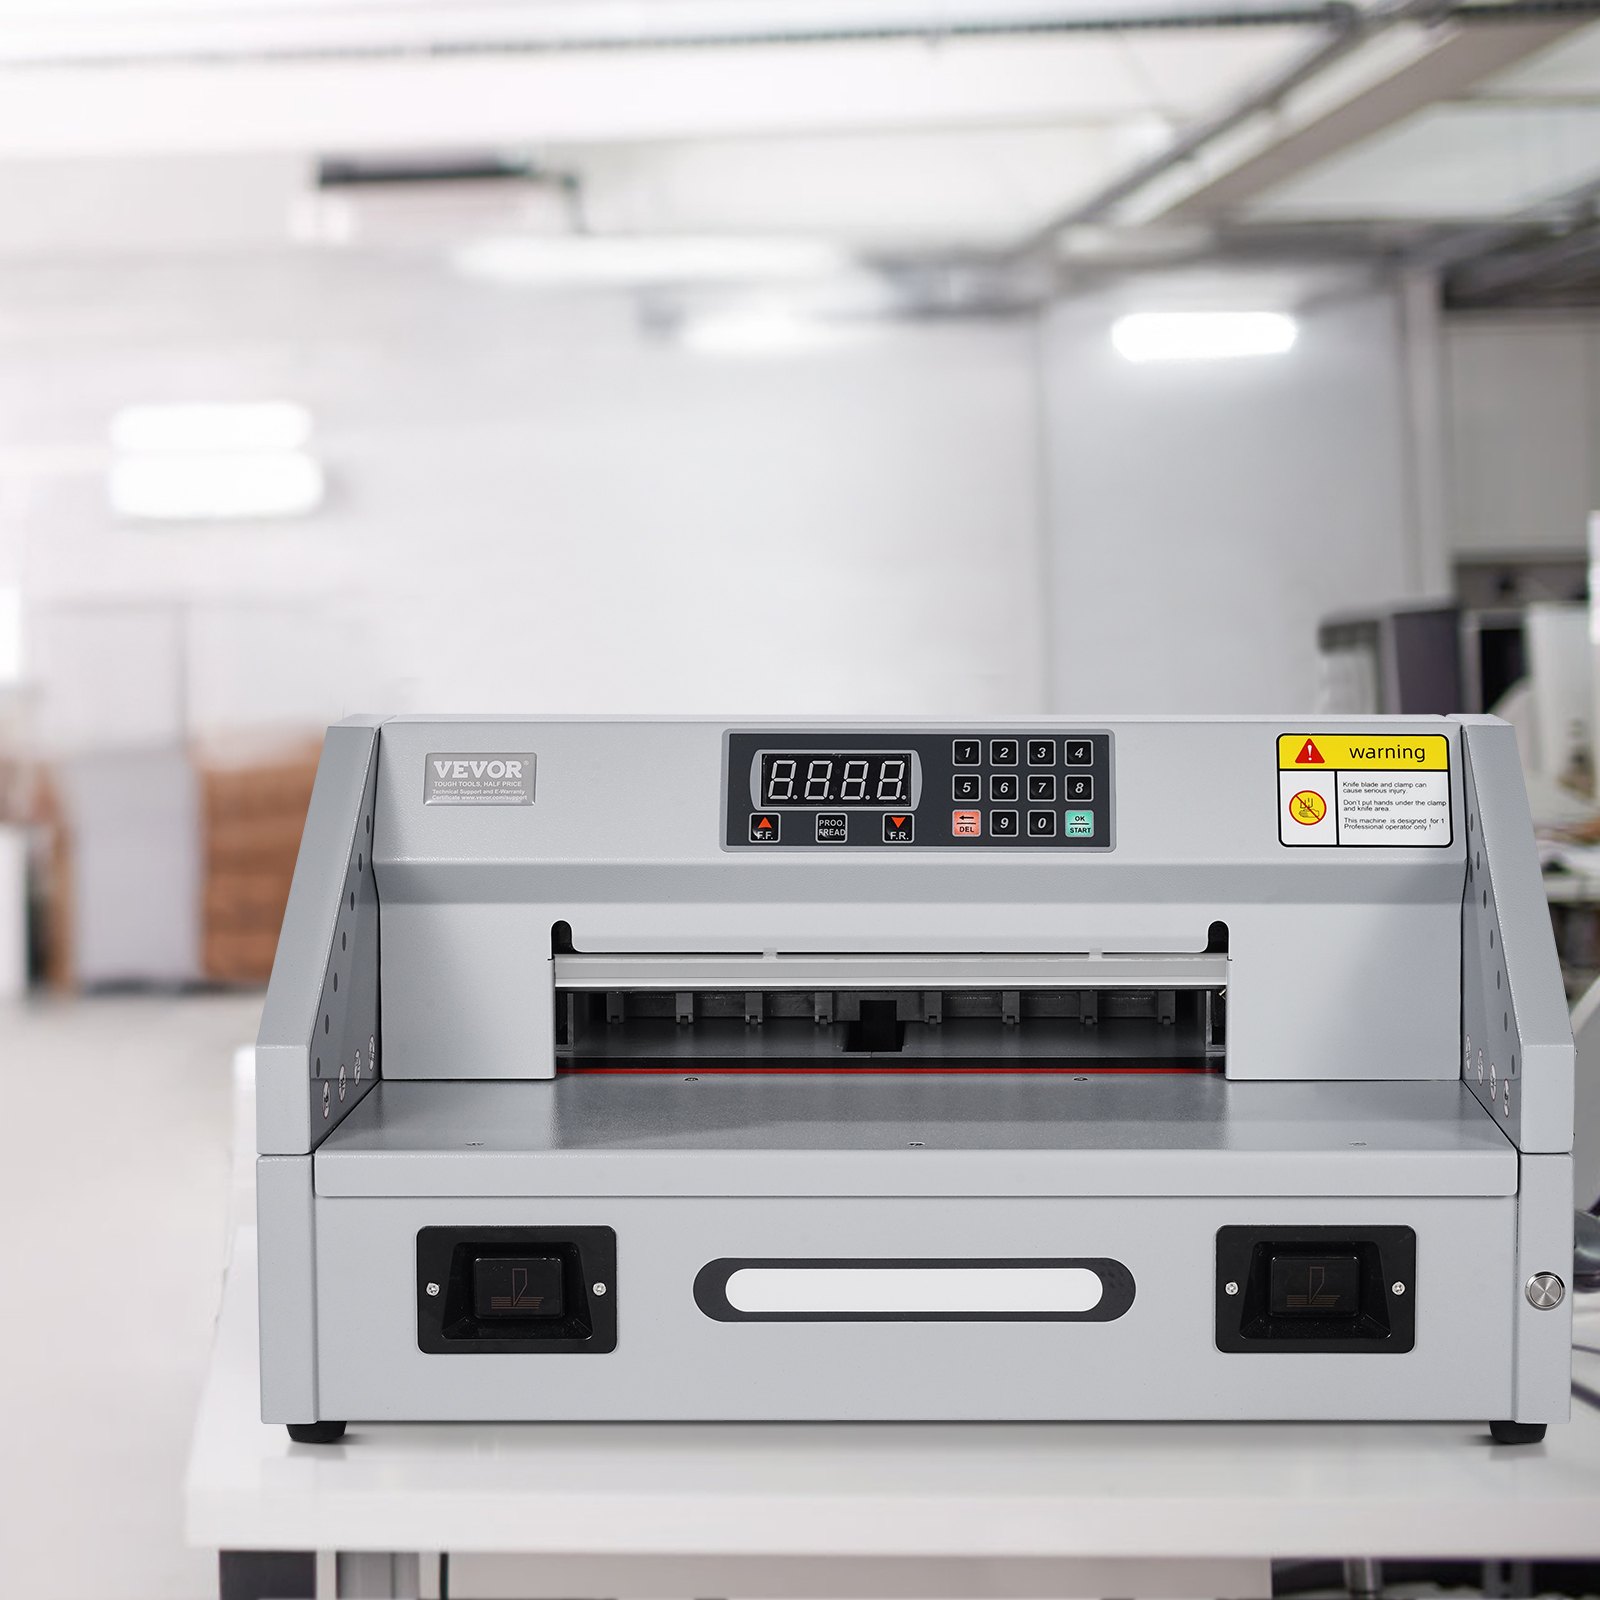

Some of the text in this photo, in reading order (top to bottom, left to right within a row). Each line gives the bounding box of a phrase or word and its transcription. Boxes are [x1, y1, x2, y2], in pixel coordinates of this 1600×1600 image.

[964, 747, 971, 758] 1
[999, 747, 1009, 758] 2
[1037, 747, 1046, 758] 3
[1074, 747, 1084, 758] 4
[1349, 744, 1426, 763] warning
[962, 782, 972, 793] 5
[1000, 782, 1009, 793] 6
[1038, 782, 1046, 793] 7
[1075, 782, 1084, 793] 8
[1394, 781, 1414, 789] clamp
[1427, 799, 1447, 807] clamp
[819, 819, 845, 827] PROO.
[1000, 817, 1009, 829] 9
[1037, 818, 1046, 829] 0
[757, 830, 774, 840] F.F.
[890, 831, 909, 840] F.R.
